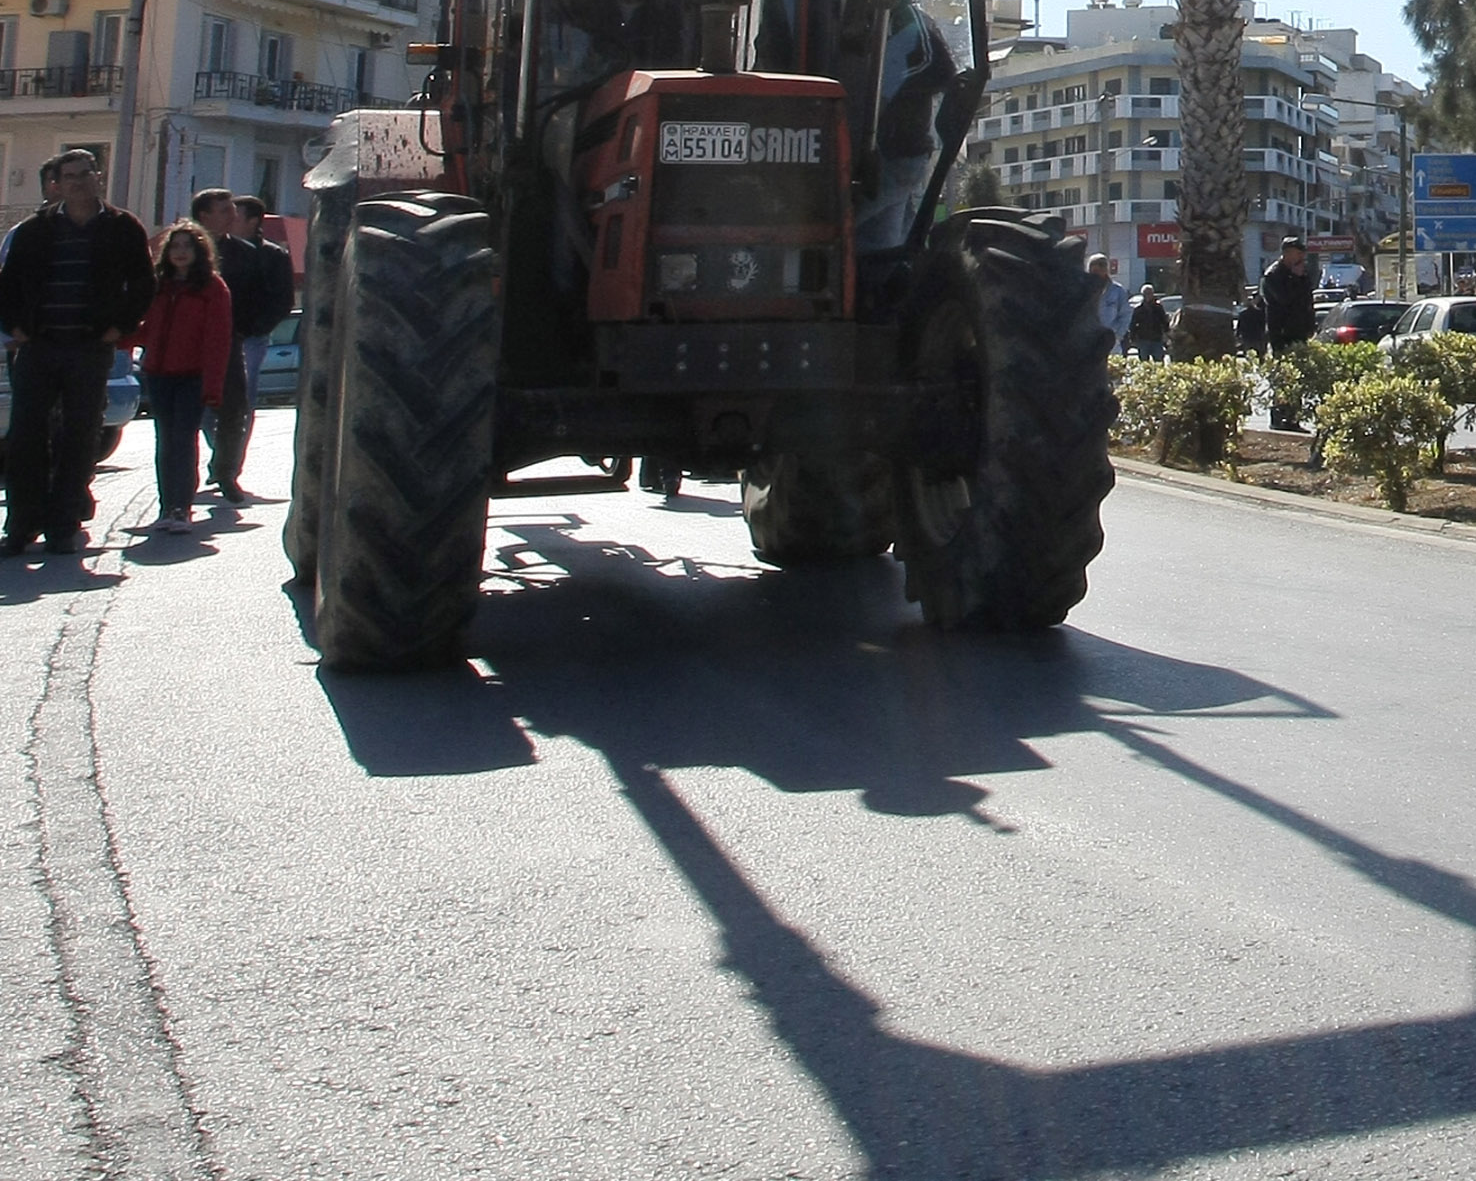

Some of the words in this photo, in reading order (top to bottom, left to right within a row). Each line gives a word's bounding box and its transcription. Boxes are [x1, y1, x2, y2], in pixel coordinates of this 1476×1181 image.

[682, 127, 747, 137] ΗΡΑΚΛΕΙΟ
[683, 138, 744, 158] 55104
[750, 127, 821, 164] SAME
